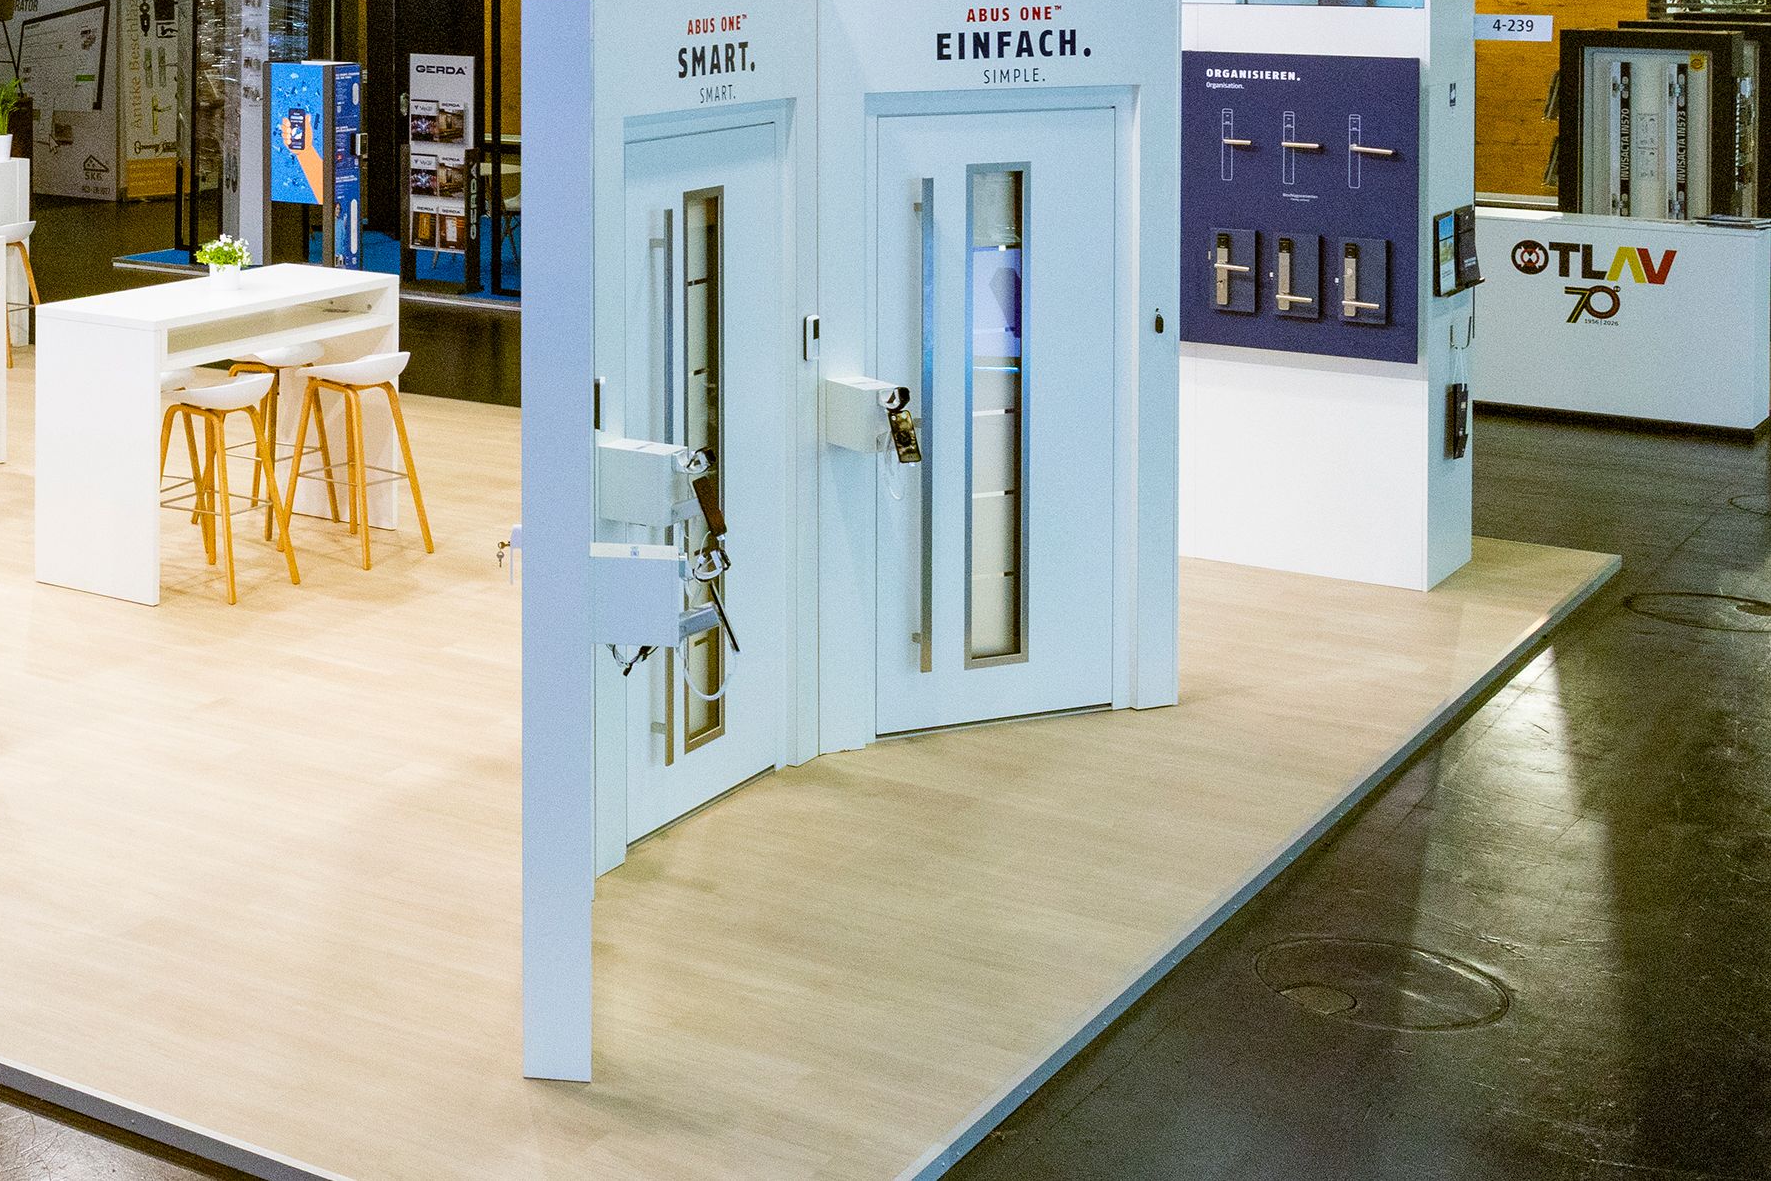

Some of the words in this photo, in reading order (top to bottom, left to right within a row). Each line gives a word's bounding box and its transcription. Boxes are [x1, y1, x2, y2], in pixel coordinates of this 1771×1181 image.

[966, 7, 1010, 23] ABUS
[687, 17, 715, 36] ABUS
[1492, 19, 1534, 32] 4-239
[936, 29, 1092, 61] EINFACH.
[678, 41, 756, 78] SMART.
[415, 64, 466, 76] GERDA
[983, 67, 1046, 84] SIMPLE.
[1206, 68, 1301, 81] ORGANISIEREN.
[699, 84, 736, 104] SMART.
[1206, 81, 1245, 89] Organisation.
[1620, 135, 1630, 181] INVISACTA
[1677, 139, 1686, 184] INVISACTA
[1511, 239, 1677, 285] OTLAV
[1564, 285, 1621, 324] 70
